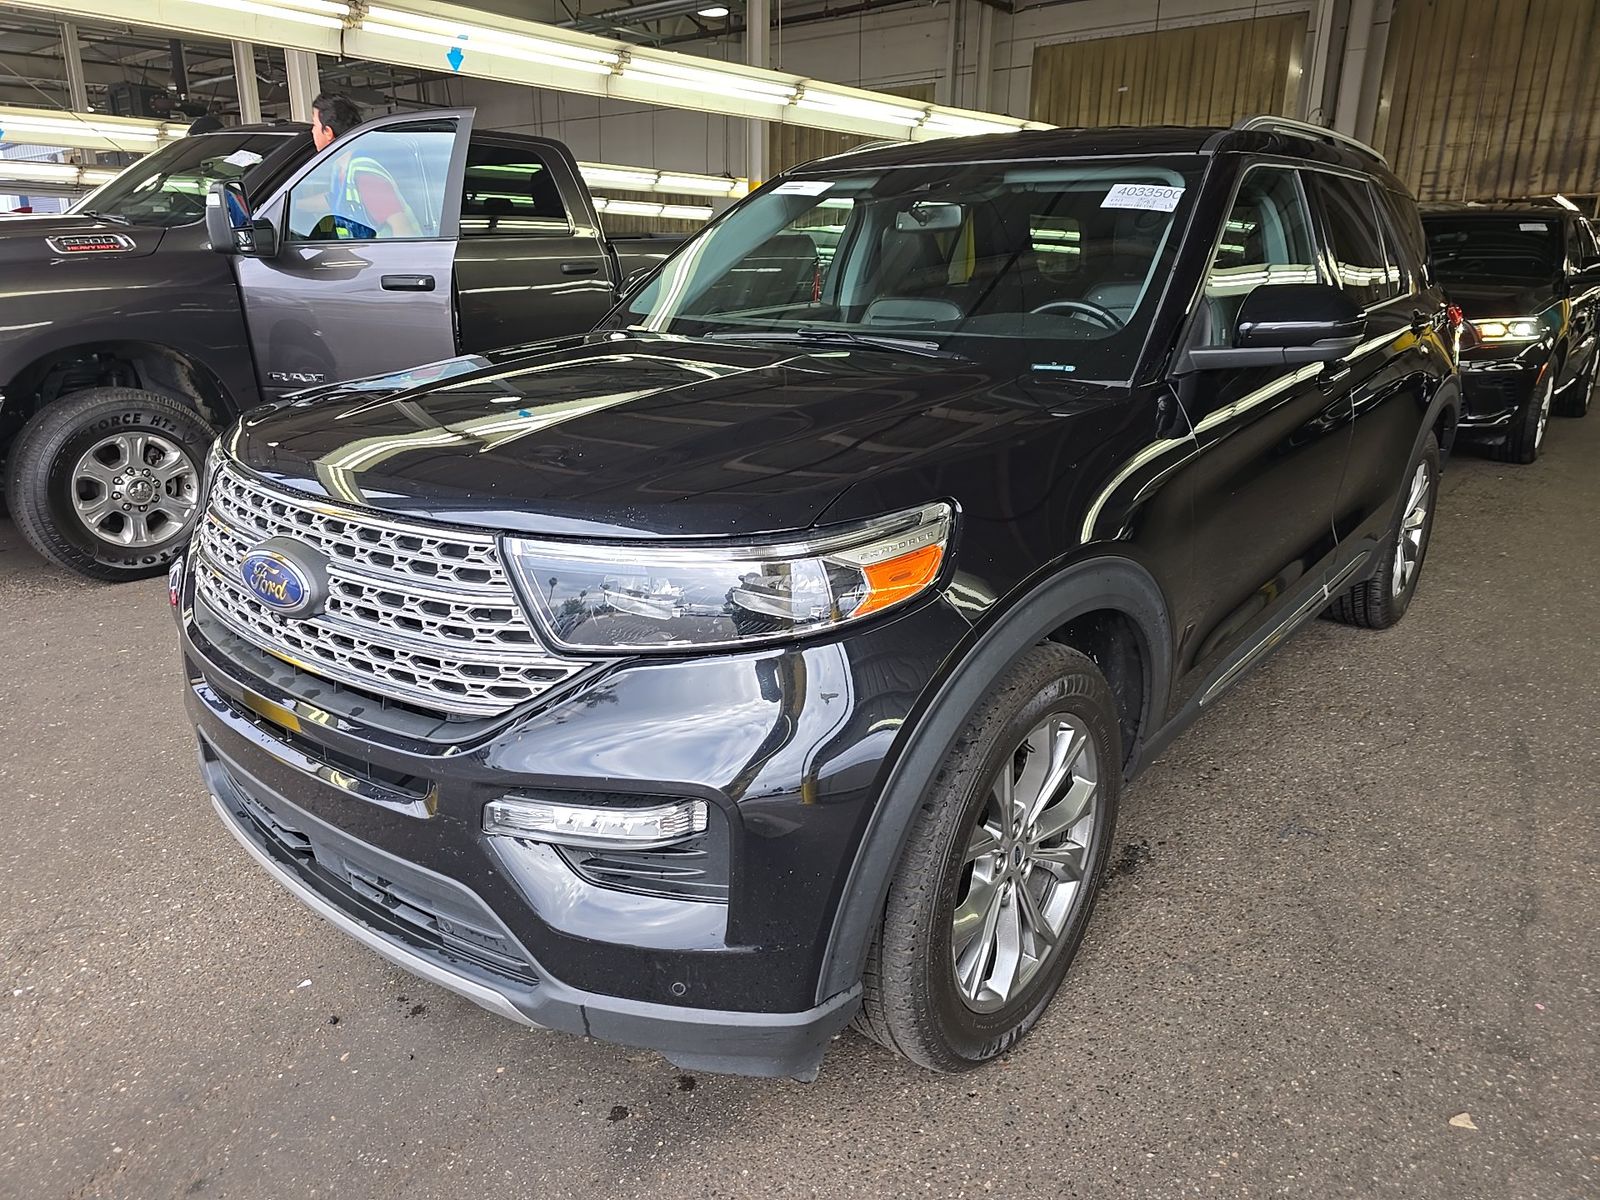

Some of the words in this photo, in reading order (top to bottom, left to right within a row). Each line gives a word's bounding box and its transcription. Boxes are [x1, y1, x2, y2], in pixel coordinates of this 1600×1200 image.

[62, 236, 116, 246] 2500
[266, 370, 325, 383] RAM
[859, 531, 934, 560] EXPLORER
[250, 561, 289, 601] Ford
